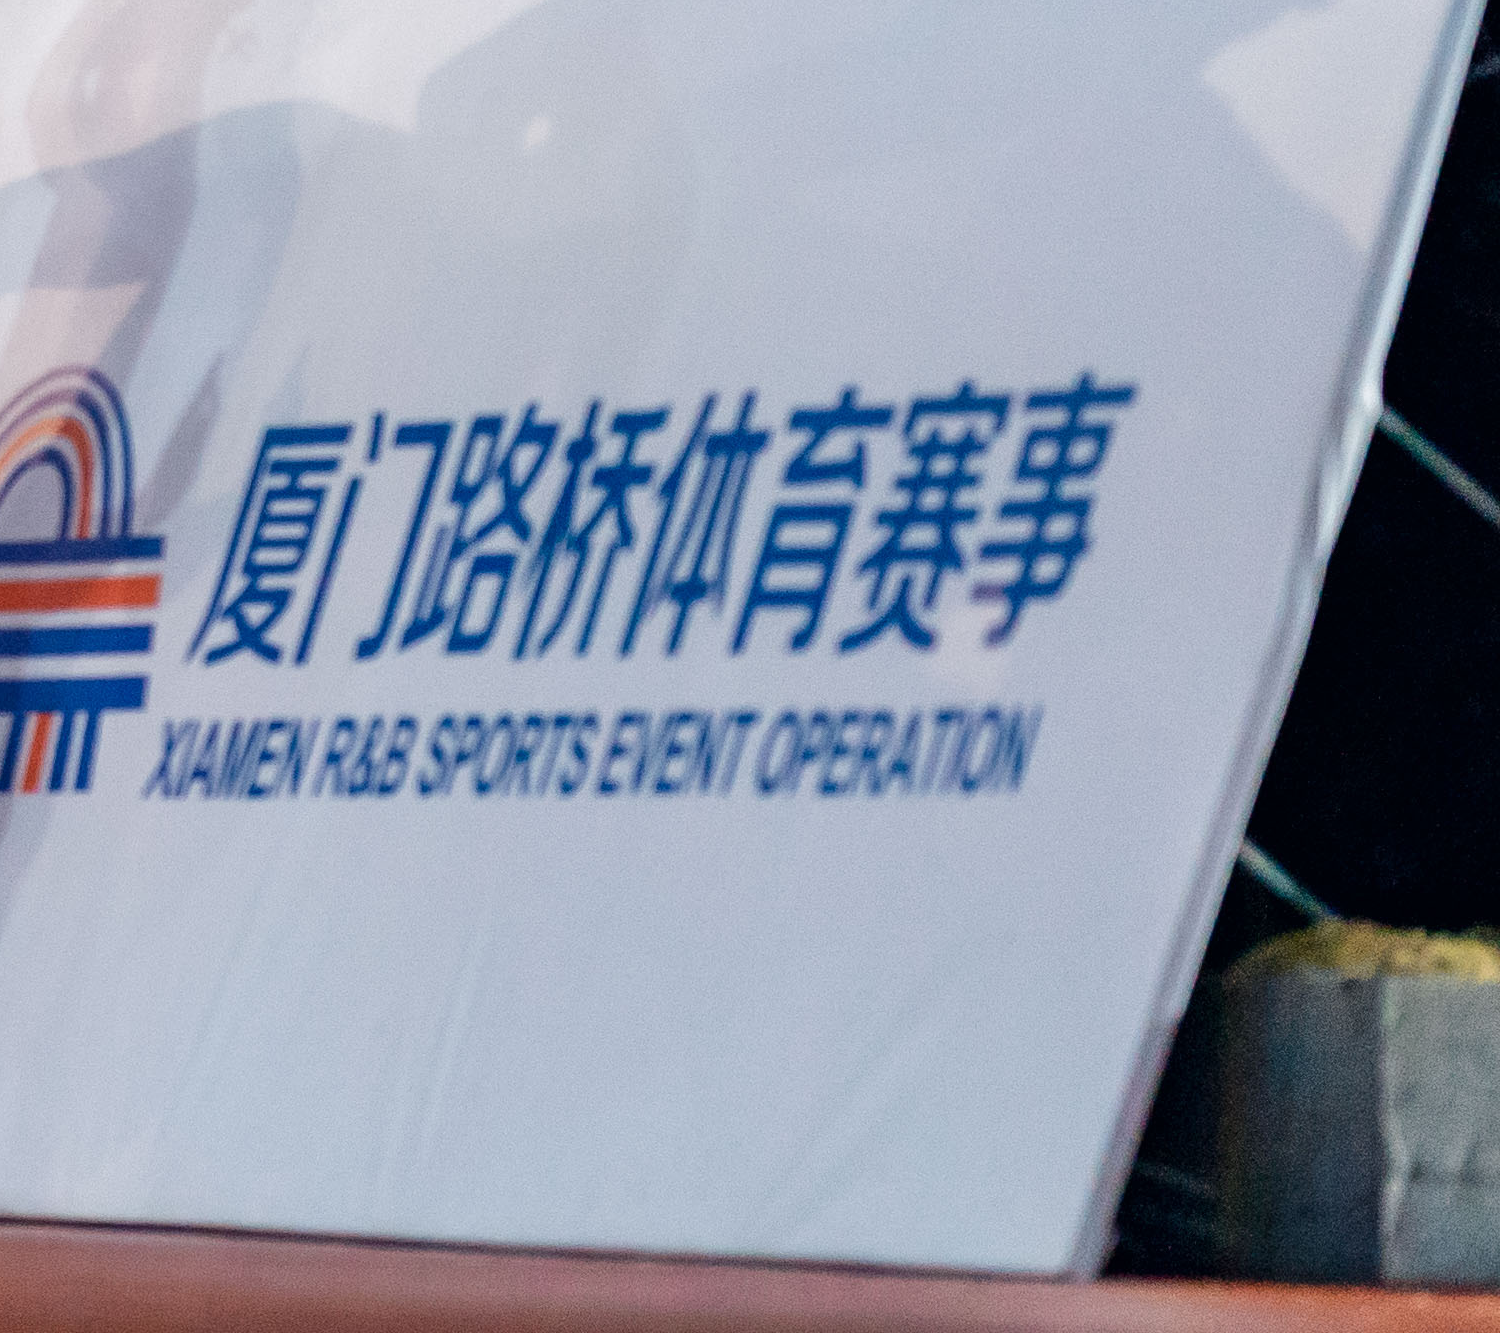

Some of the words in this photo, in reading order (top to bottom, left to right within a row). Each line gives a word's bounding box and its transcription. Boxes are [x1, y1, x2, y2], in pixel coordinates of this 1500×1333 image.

[184, 371, 1137, 667] 厦门路桥体育赛事
[141, 717, 312, 799] XIAMEN
[308, 716, 422, 798] R&B
[412, 711, 602, 798] SPORTS
[596, 709, 762, 797] EVENT
[752, 705, 1043, 797] OPERATION
